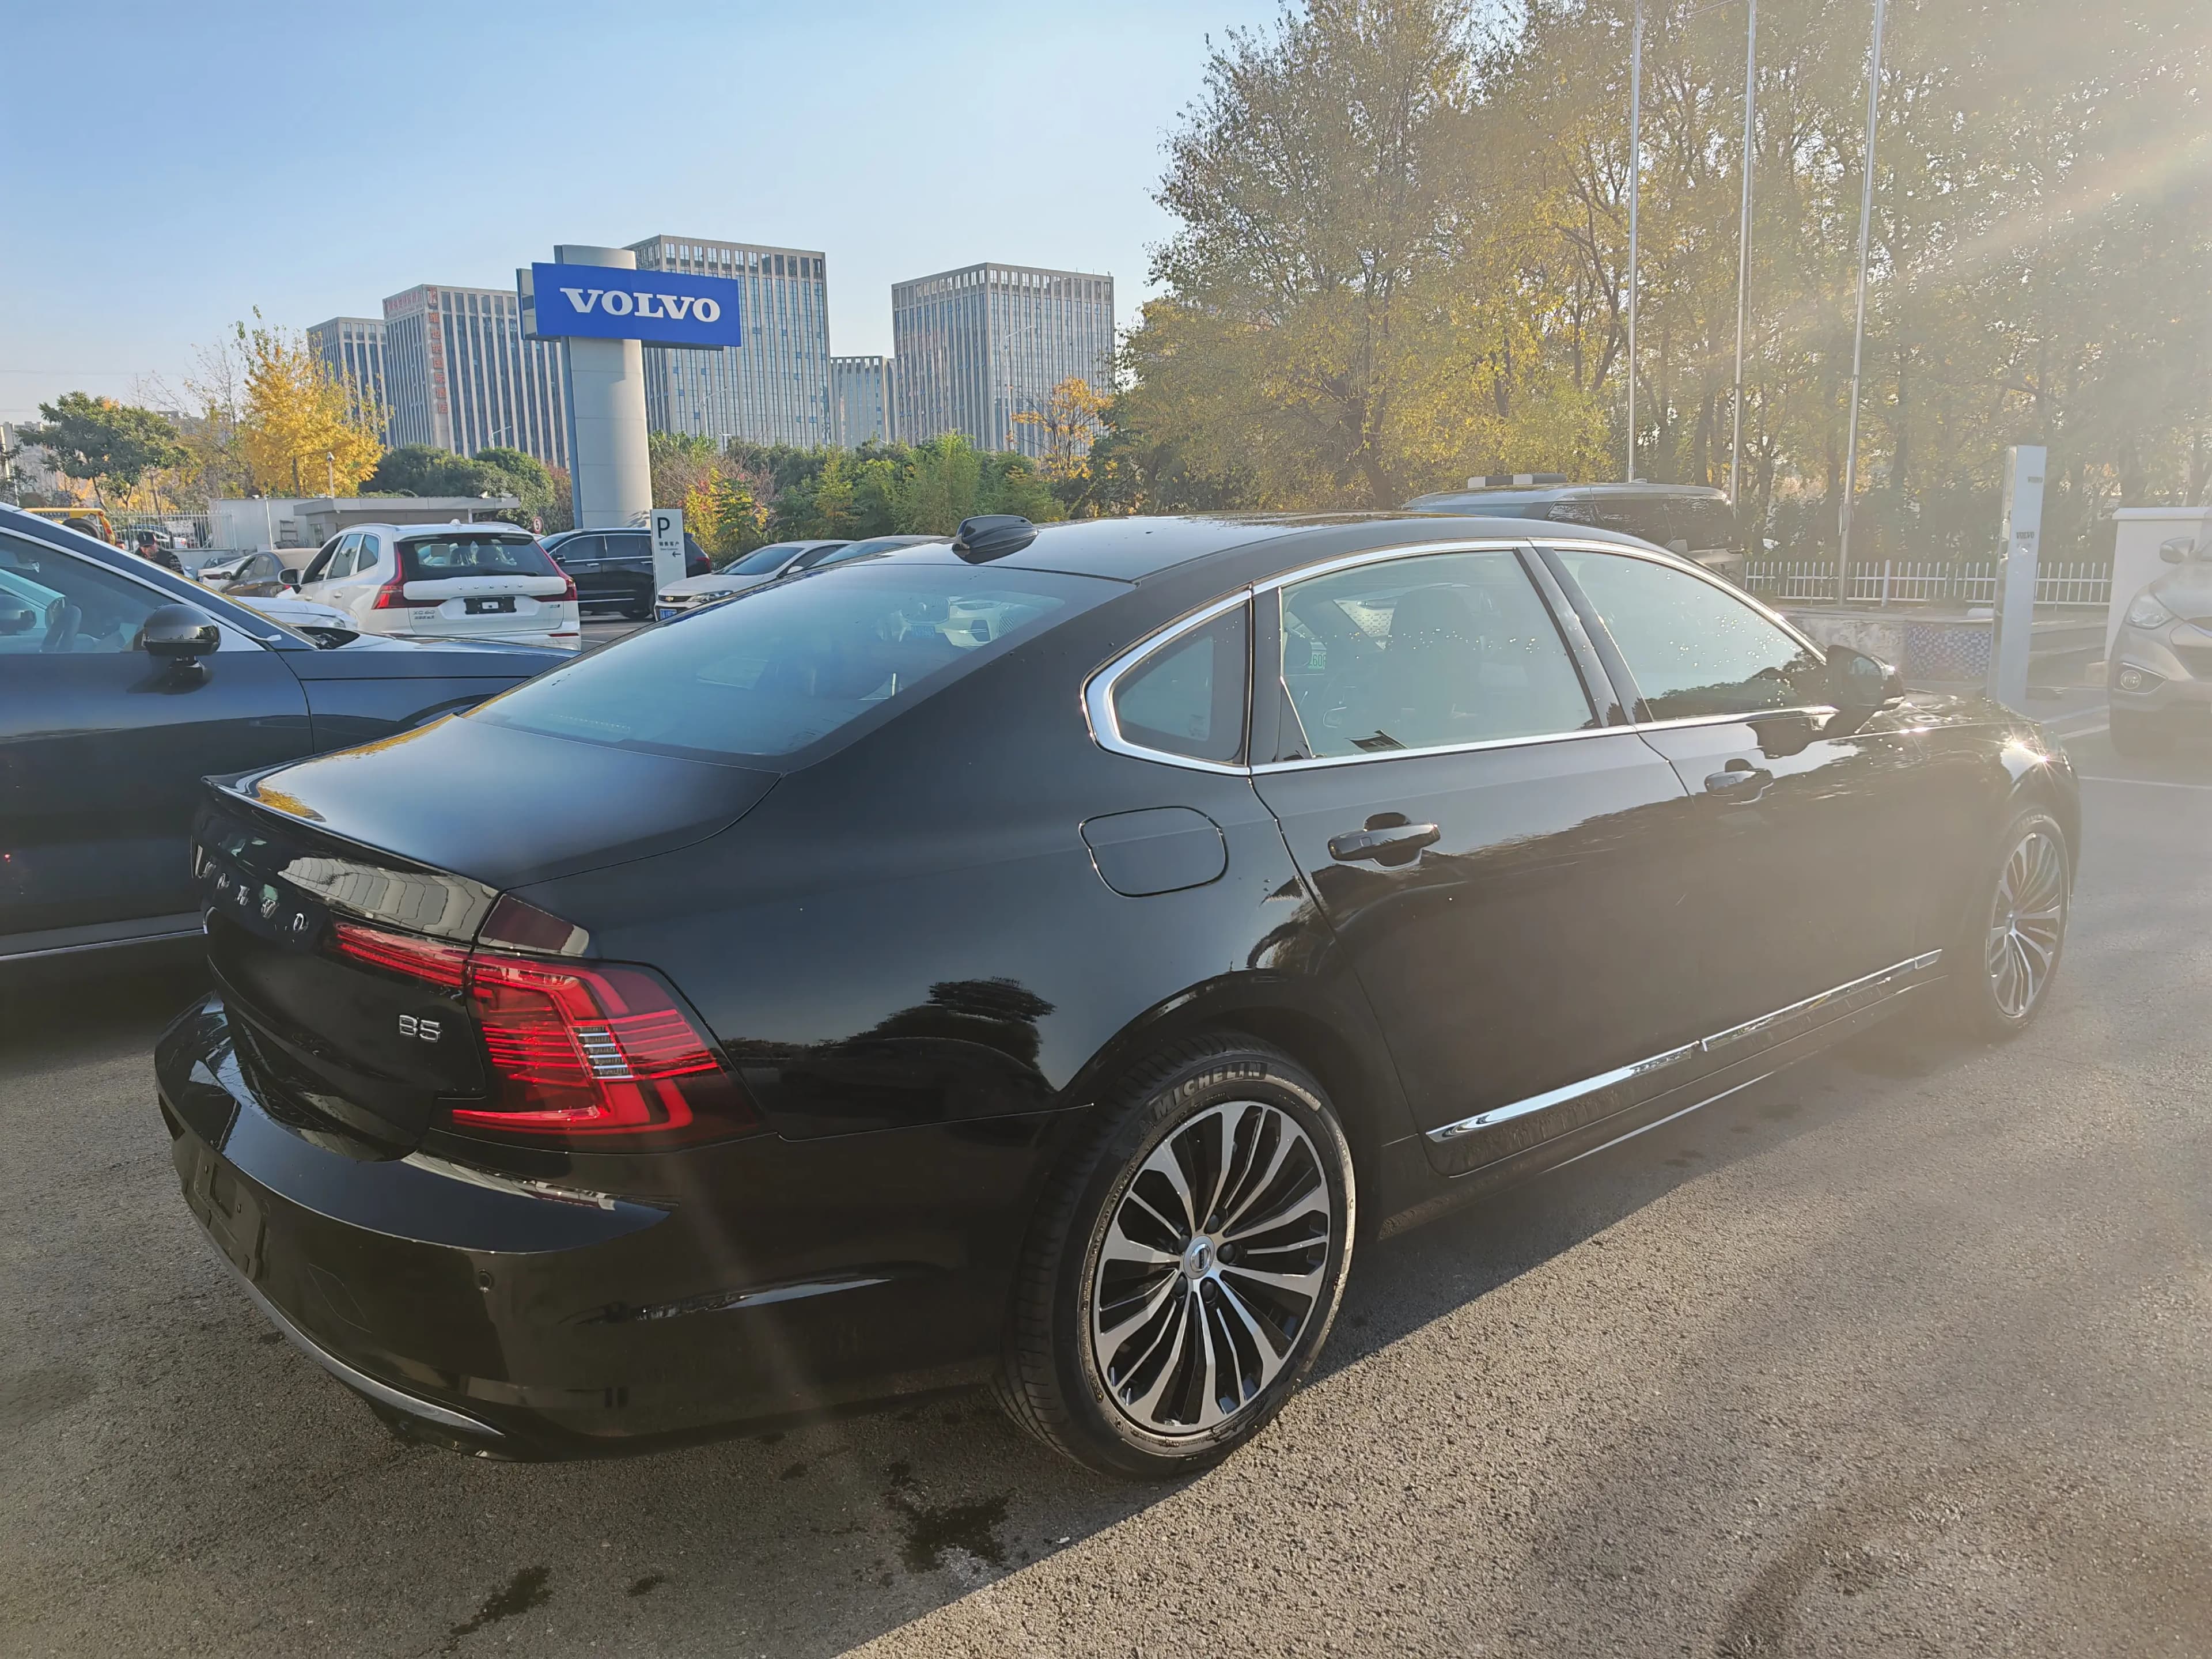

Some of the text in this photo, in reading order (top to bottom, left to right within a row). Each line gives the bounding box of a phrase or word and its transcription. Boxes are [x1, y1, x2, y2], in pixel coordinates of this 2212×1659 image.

[559, 287, 720, 322] VOLVO
[657, 517, 670, 539] P
[399, 1015, 440, 1042] B5
[1153, 1062, 1262, 1120] MICHELIN
